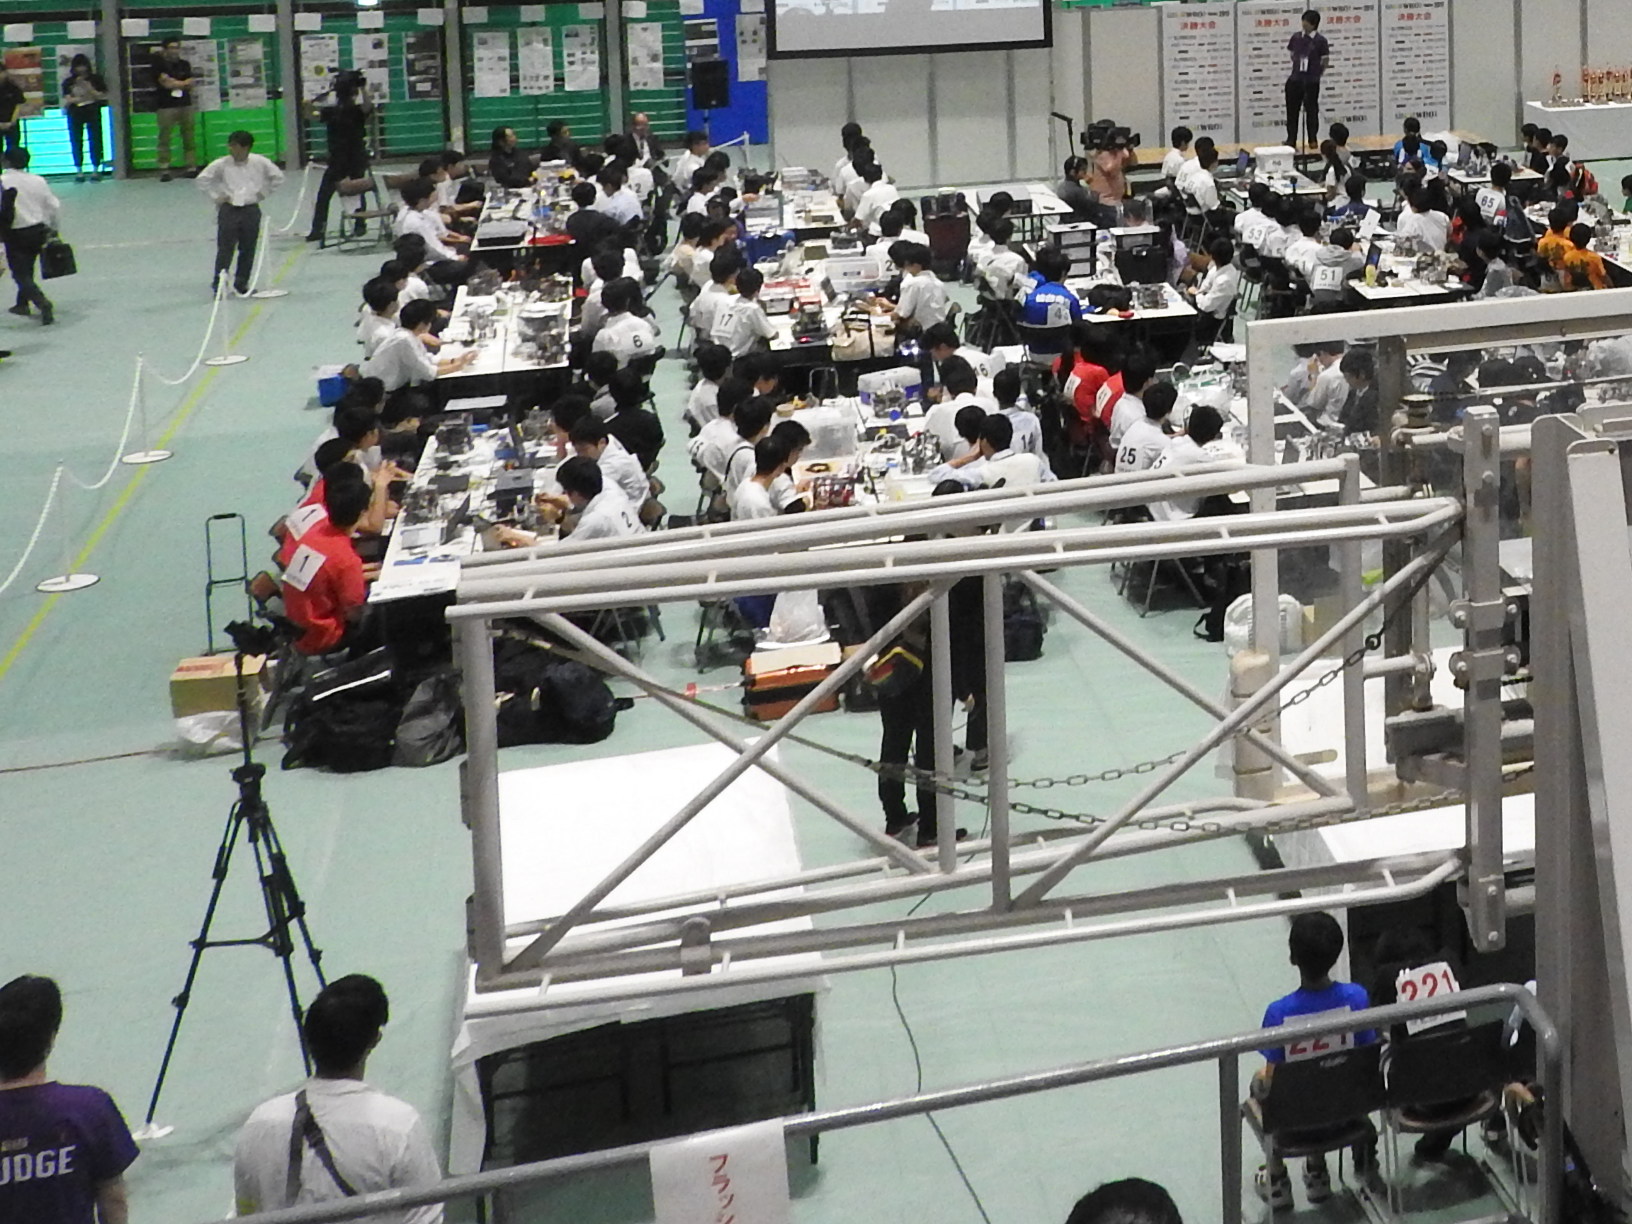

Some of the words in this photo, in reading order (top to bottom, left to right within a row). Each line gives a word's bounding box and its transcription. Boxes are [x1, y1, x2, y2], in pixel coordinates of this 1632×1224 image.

[1481, 194, 1495, 208] 65
[1247, 228, 1263, 240] 53
[1319, 268, 1336, 280] 51
[719, 313, 734, 327] 17
[633, 334, 643, 348] 6
[1119, 445, 1136, 465] 25
[301, 508, 314, 522] 1
[621, 511, 633, 528] 2
[300, 555, 310, 572] 1
